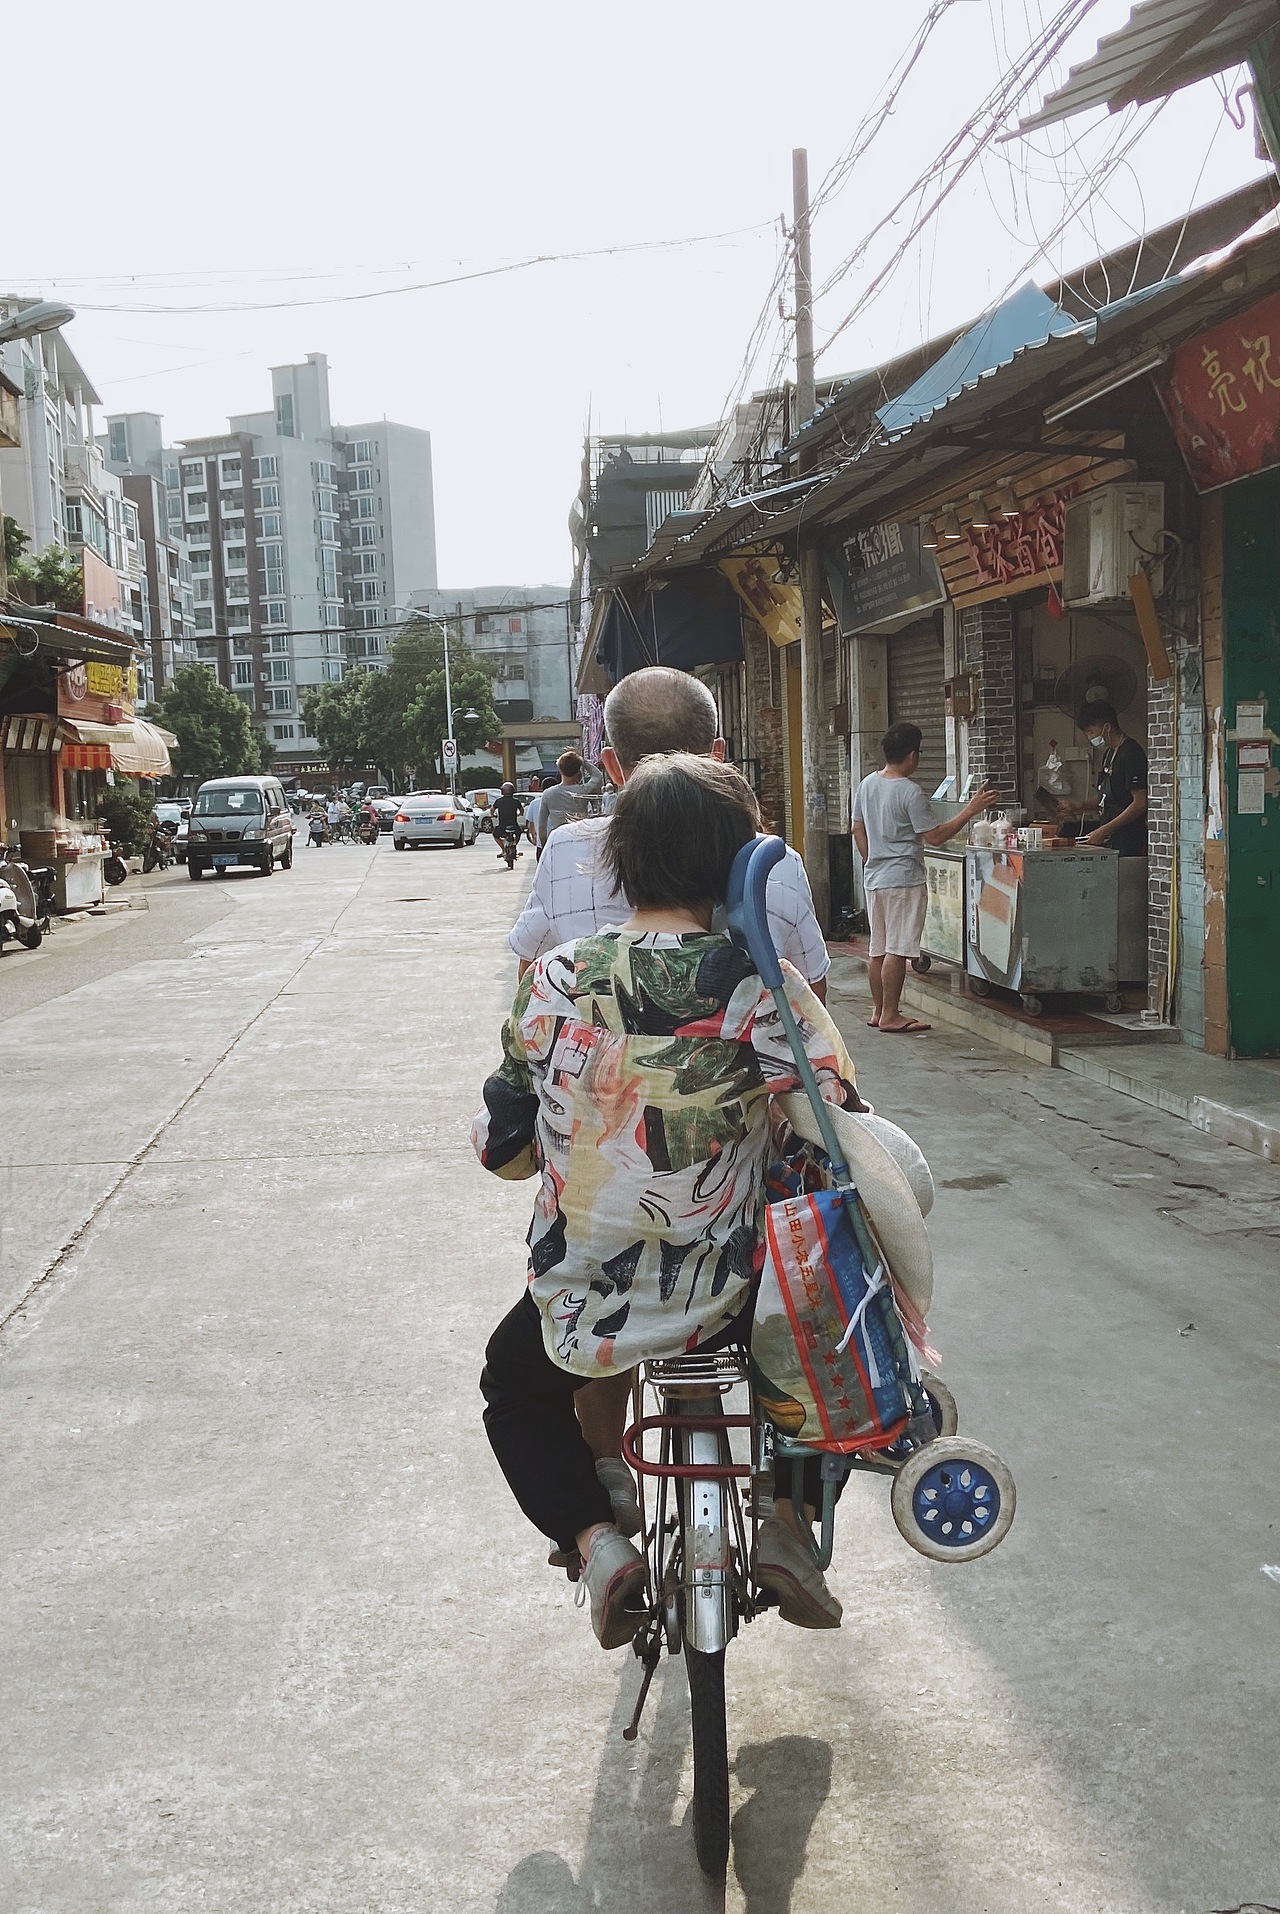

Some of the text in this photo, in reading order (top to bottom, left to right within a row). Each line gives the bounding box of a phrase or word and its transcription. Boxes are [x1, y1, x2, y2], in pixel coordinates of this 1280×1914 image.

[1201, 335, 1280, 417] 亮记
[963, 482, 1079, 585] 土家酱香
